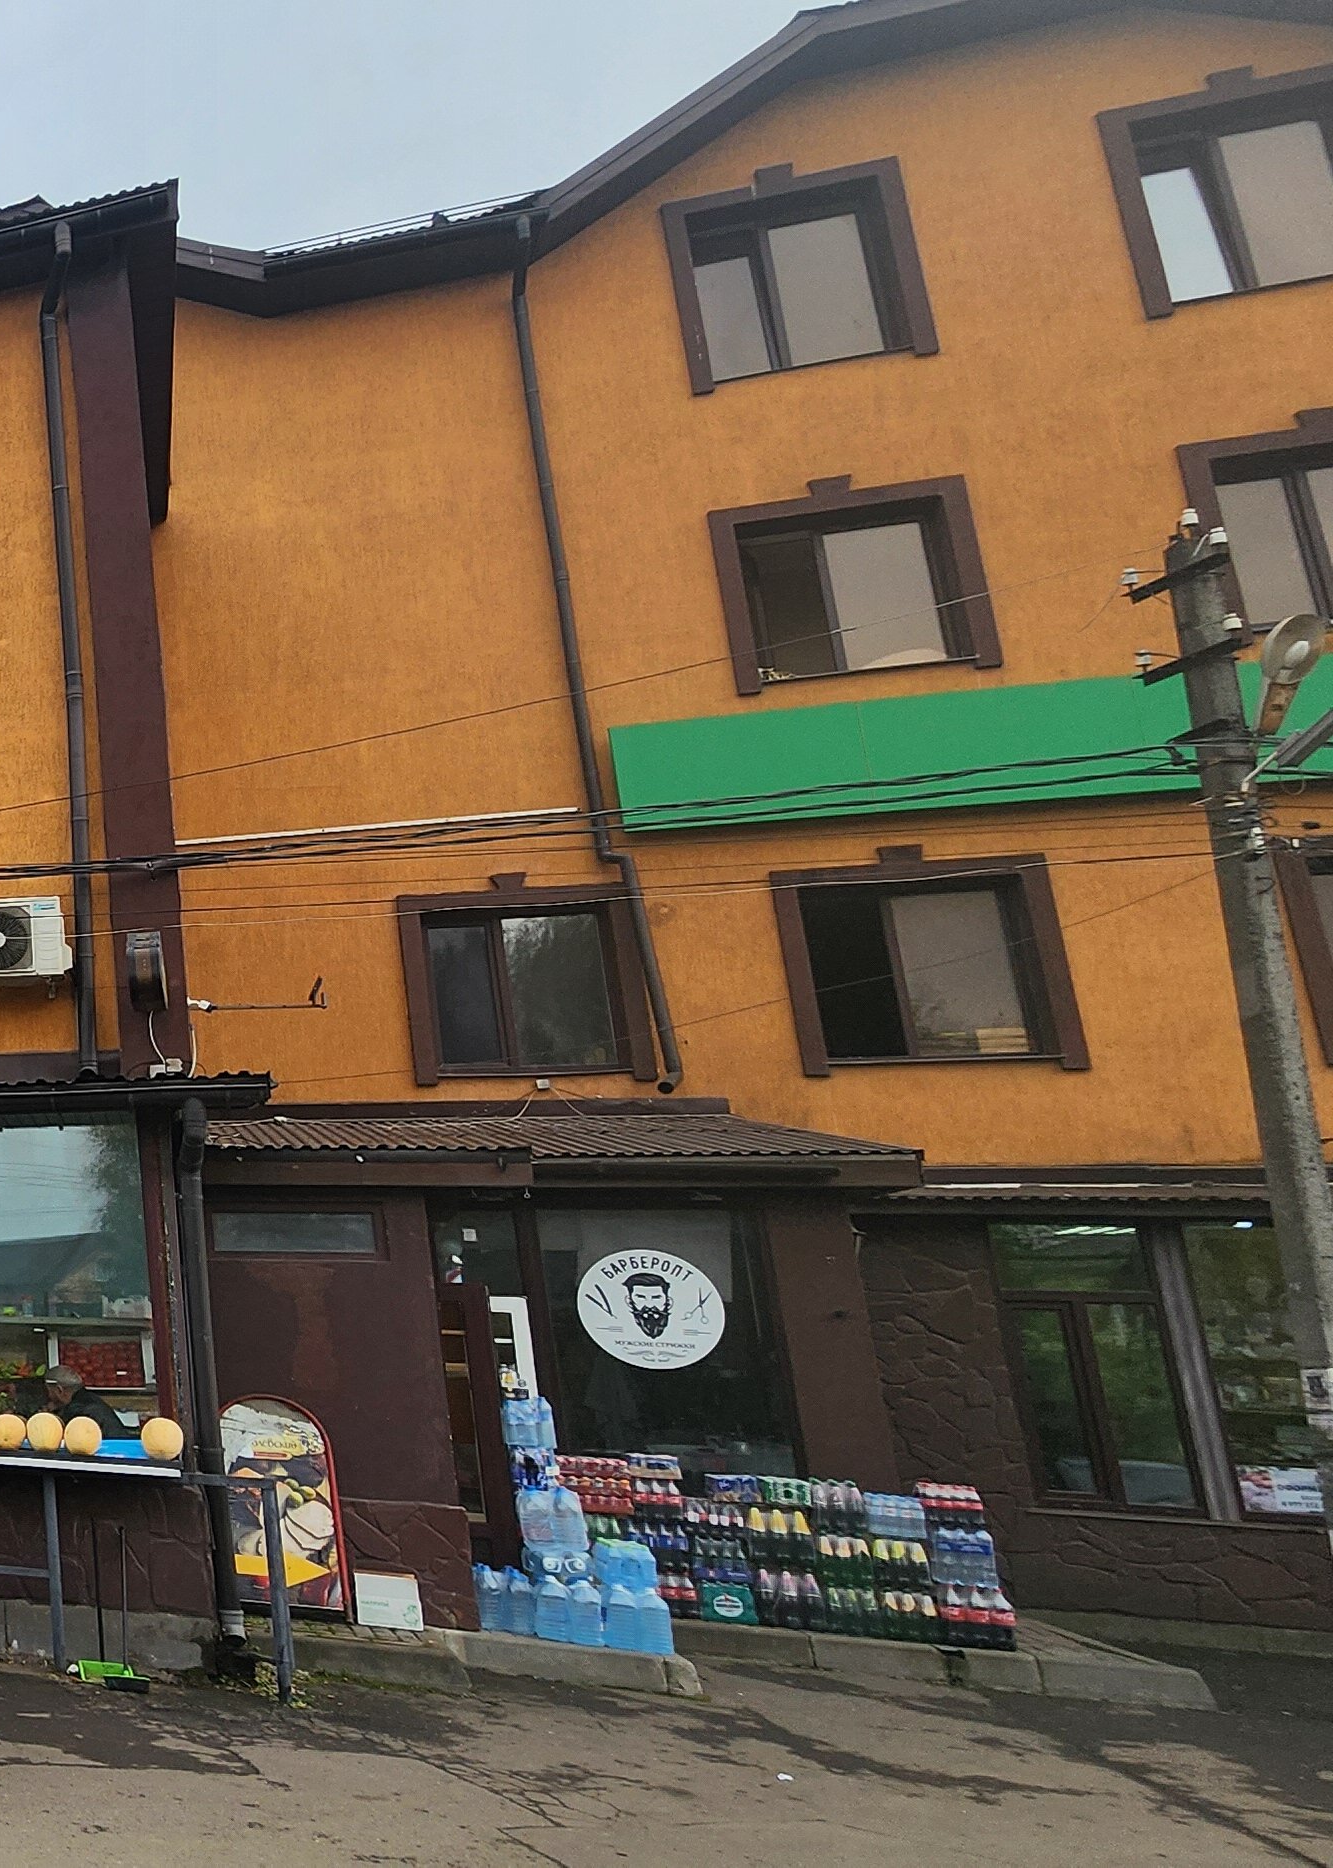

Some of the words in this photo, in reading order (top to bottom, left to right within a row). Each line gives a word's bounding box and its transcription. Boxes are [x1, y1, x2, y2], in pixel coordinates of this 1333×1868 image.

[600, 1256, 694, 1281] БАРБЕРОПТ
[614, 1340, 653, 1348] МУЖСКИЕ
[655, 1341, 696, 1349] СТРИЖКИ
